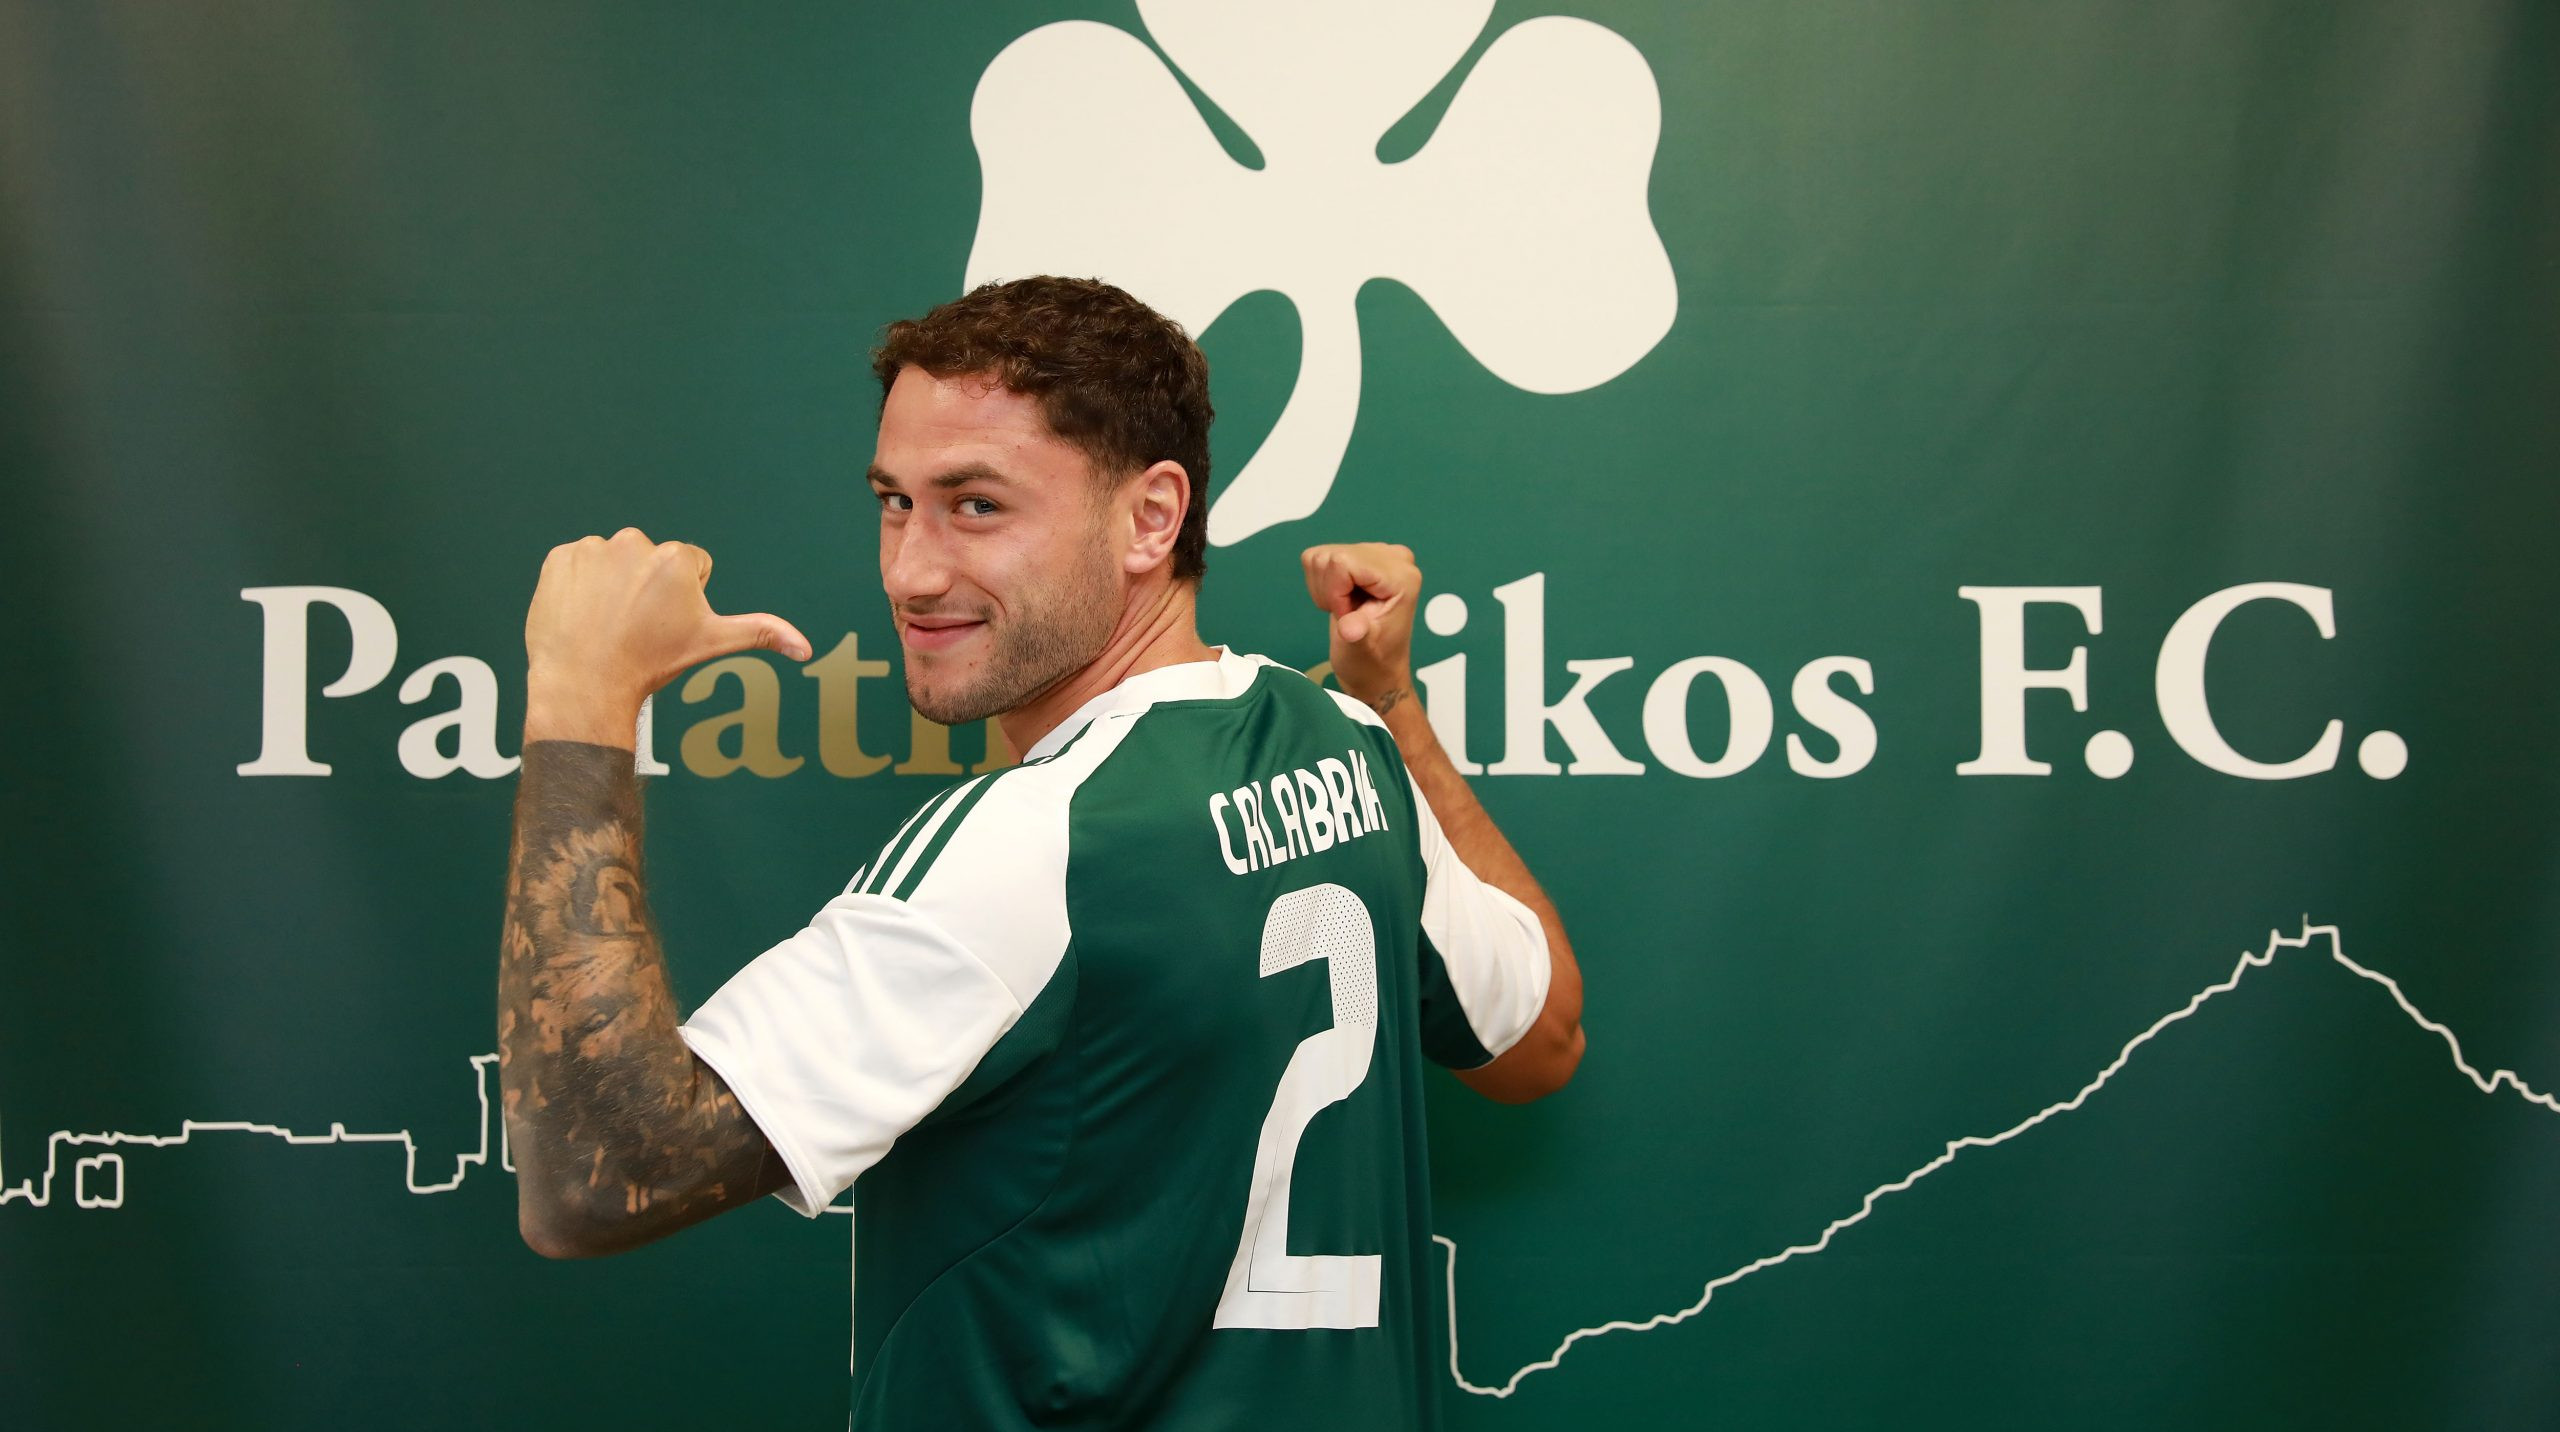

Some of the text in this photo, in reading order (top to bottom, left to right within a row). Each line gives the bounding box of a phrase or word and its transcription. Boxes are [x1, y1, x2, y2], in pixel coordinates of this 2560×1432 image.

[236, 572, 2409, 780] Paatikos F.C.
[1209, 749, 1389, 876] CALABRIA
[1212, 882, 1382, 1330] 2
